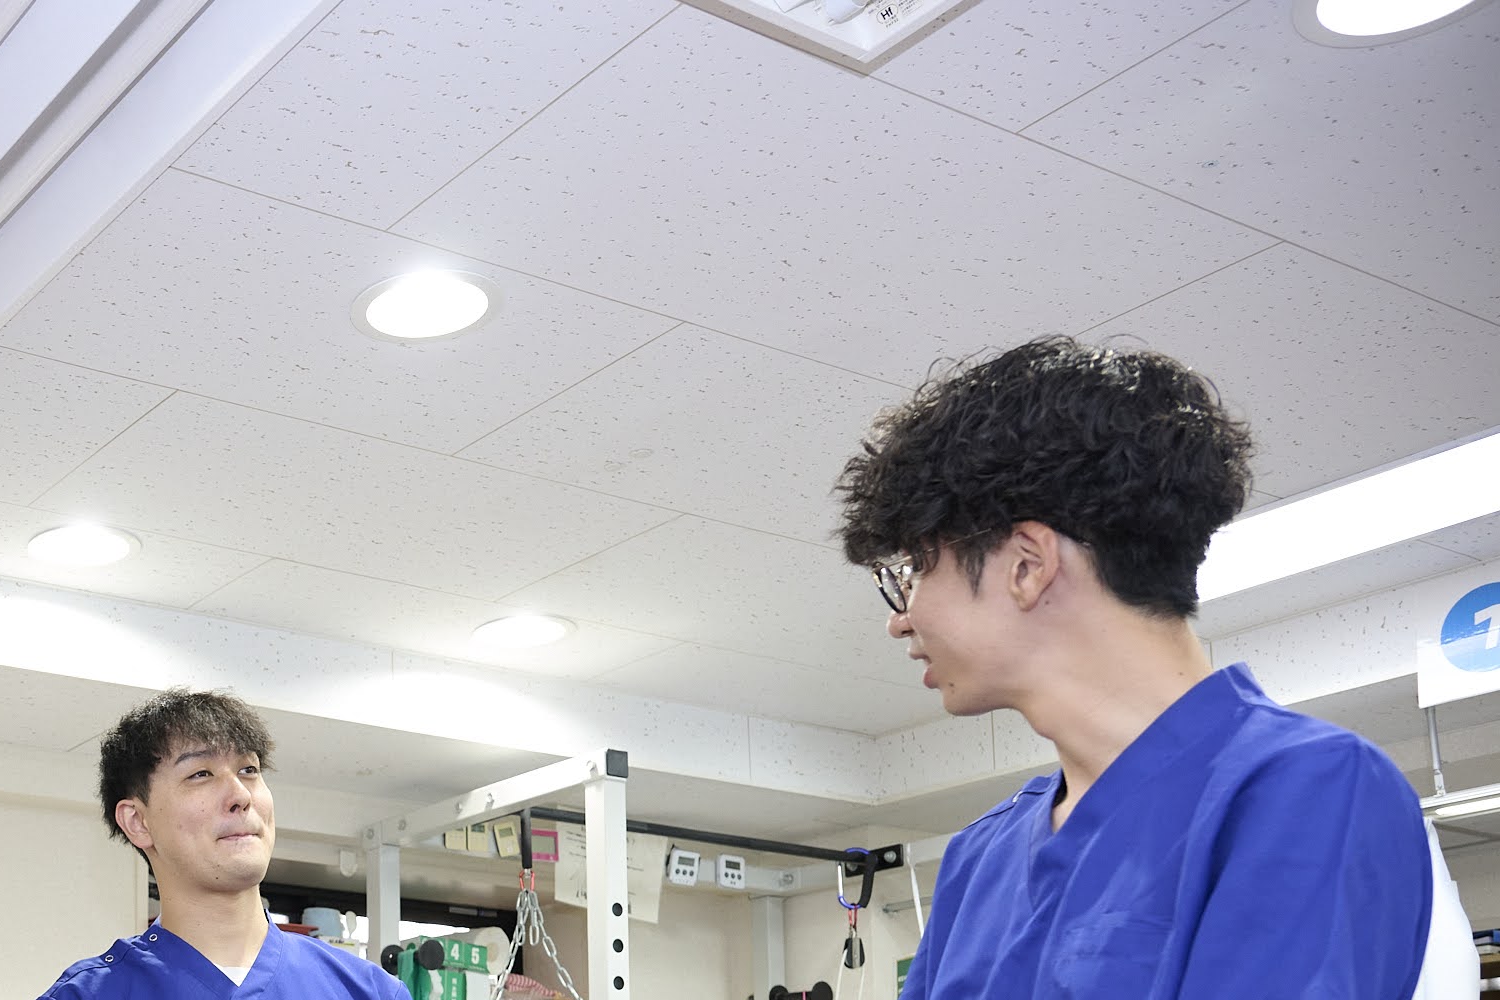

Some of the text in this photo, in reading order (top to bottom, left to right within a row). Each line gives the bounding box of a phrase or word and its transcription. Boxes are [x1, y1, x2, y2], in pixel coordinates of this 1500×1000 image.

[881, 7, 894, 20] Hf
[450, 943, 460, 960] 4
[471, 947, 480, 964] 5
